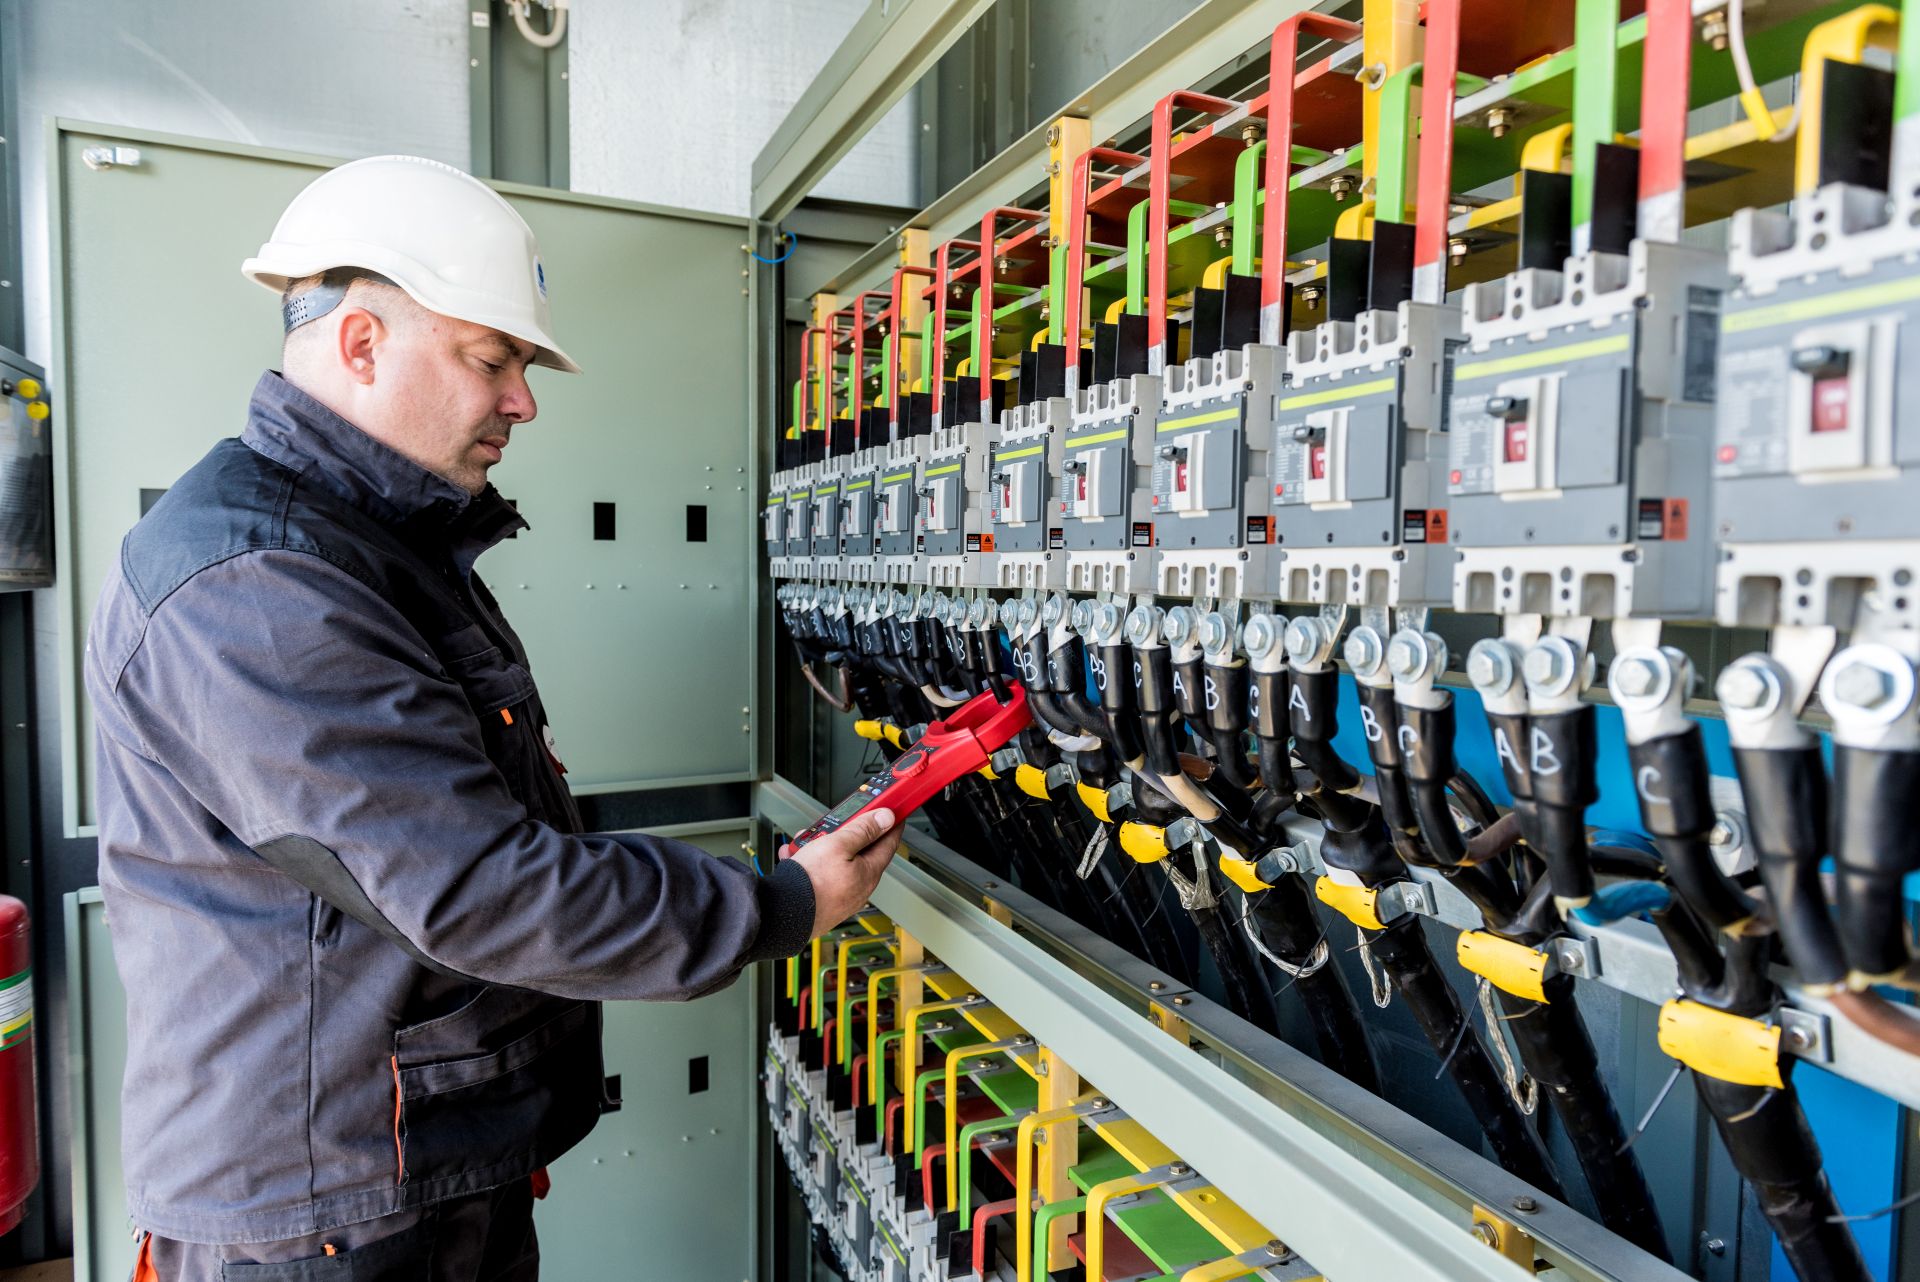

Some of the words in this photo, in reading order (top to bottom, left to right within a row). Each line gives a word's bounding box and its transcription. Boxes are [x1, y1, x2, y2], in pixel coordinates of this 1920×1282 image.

[1013, 647, 1025, 672] A
[1023, 652, 1038, 682] B
[1090, 653, 1099, 675] A
[1133, 661, 1142, 688] C
[1173, 670, 1188, 700] A
[1204, 674, 1220, 710] B
[1249, 684, 1259, 717] C
[1288, 683, 1311, 722] A
[1360, 704, 1382, 742] B
[1397, 724, 1418, 757] C
[1495, 727, 1523, 775] A
[1530, 726, 1562, 775] B
[1638, 765, 1671, 804] C
